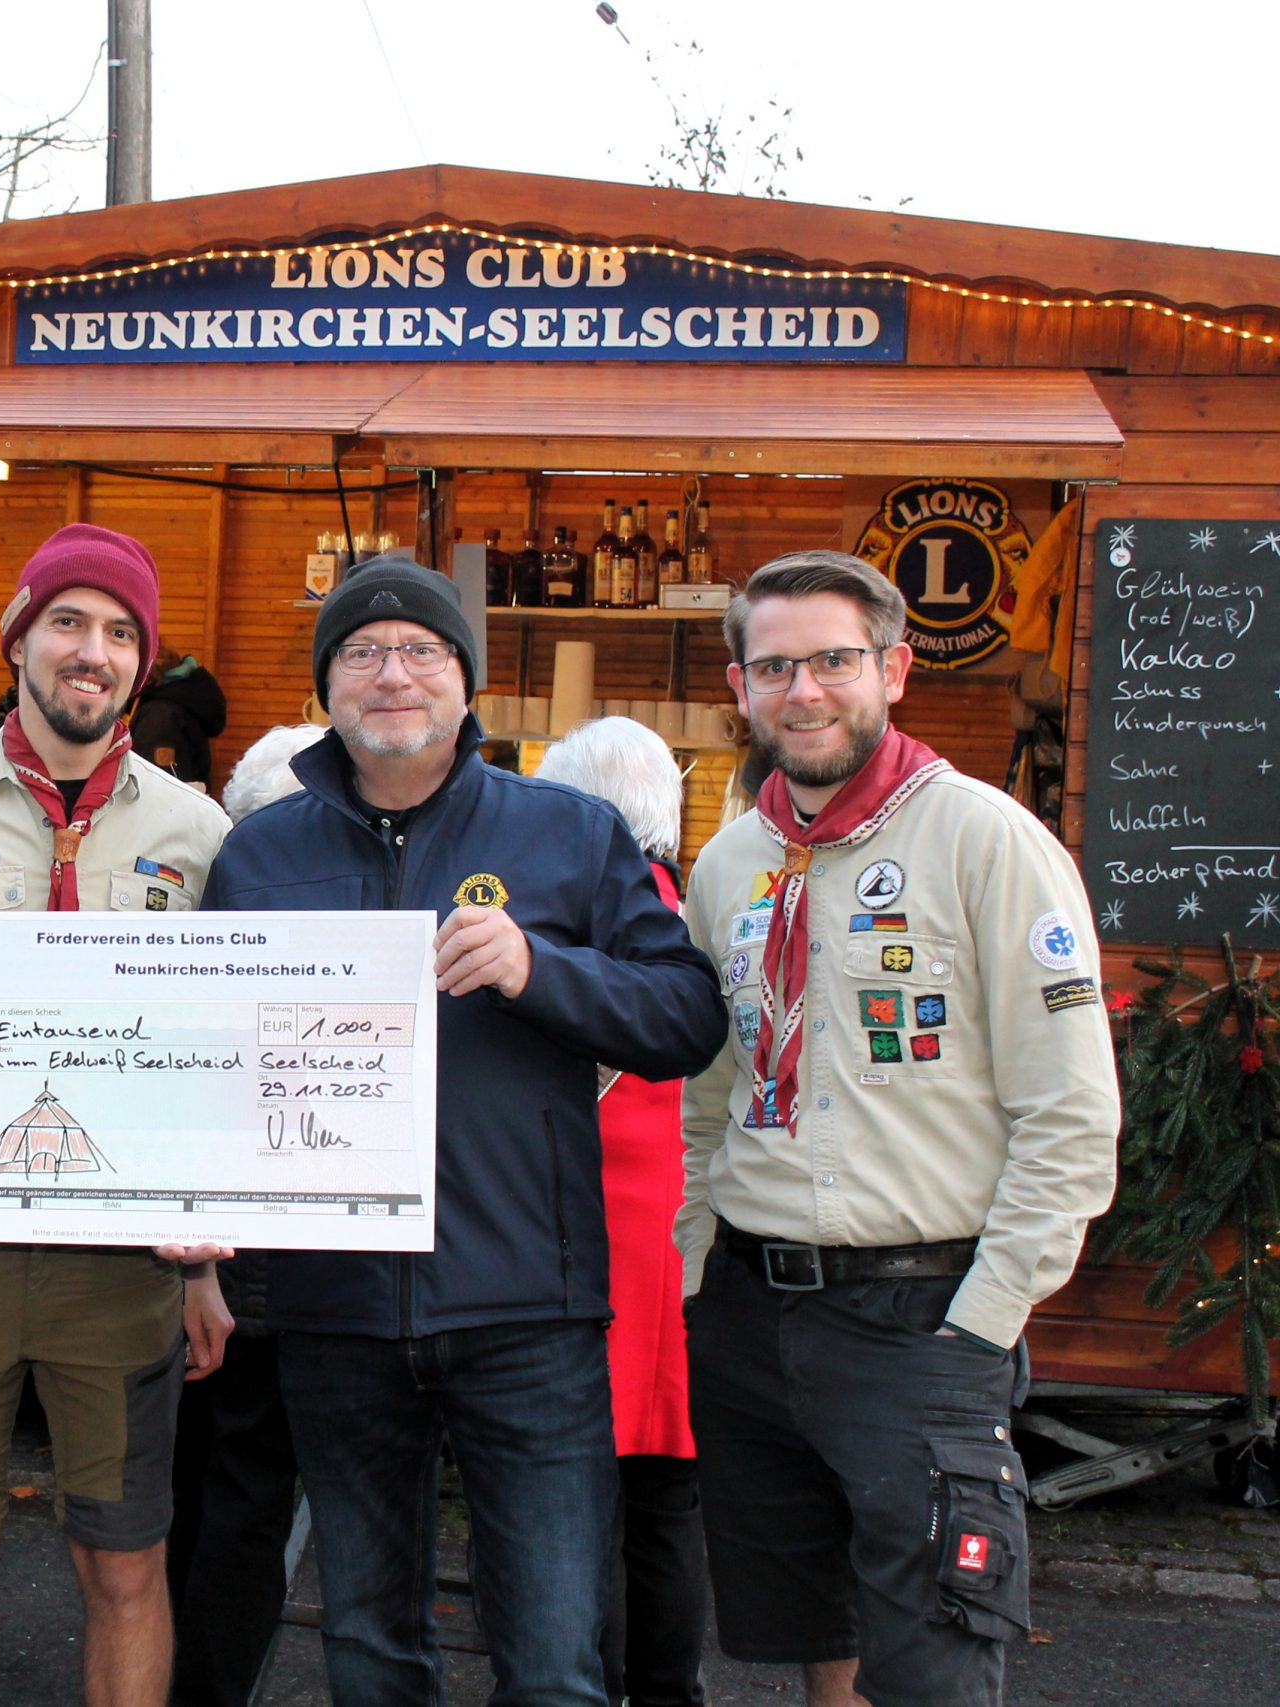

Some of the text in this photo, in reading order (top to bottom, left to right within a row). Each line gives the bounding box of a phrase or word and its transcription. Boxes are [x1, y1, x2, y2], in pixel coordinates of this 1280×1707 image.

[270, 247, 627, 289] LIONS CLUB
[29, 306, 880, 352] NEUNKIRCHEN-SEELSCHEID
[896, 489, 999, 528] LIONS
[918, 538, 971, 604] L
[1116, 568, 1264, 599] Glühwein
[903, 623, 997, 652] TERNATIONAL
[1111, 680, 1202, 700] Schuss
[1114, 706, 1267, 740] Kinderpunsch
[1110, 754, 1180, 781] Sahne
[1109, 801, 1206, 833] Waffeln
[465, 874, 497, 886] LIONS
[475, 886, 490, 903] L
[36, 931, 267, 945] Förderverein des Lions Club
[115, 962, 357, 977] Neunkirchen-Seelscheid e. V.
[8, 1008, 33, 1016] diesen
[36, 1008, 62, 1016] Scheck
[301, 1006, 323, 1014] Betrag
[263, 1020, 293, 1032] EUR
[49, 1048, 127, 1074] Edelweiß
[133, 1050, 244, 1070] Seelscheid
[258, 1051, 386, 1074] Seelscheid
[259, 1081, 393, 1098] 29.11.2025
[26, 1190, 55, 1198] geändert
[73, 1191, 107, 1199] gestrichen
[149, 1192, 174, 1200] Angabe
[195, 1193, 238, 1201] Zahlungsfrist
[294, 1194, 304, 1202] gilt
[102, 1201, 122, 1209] IBAN
[263, 1204, 289, 1215] Betrag
[370, 1205, 387, 1213] Text
[32, 1229, 51, 1237] Bitte
[83, 1230, 100, 1238] Feld
[103, 1230, 123, 1238] nicht
[125, 1231, 172, 1239] beschriften
